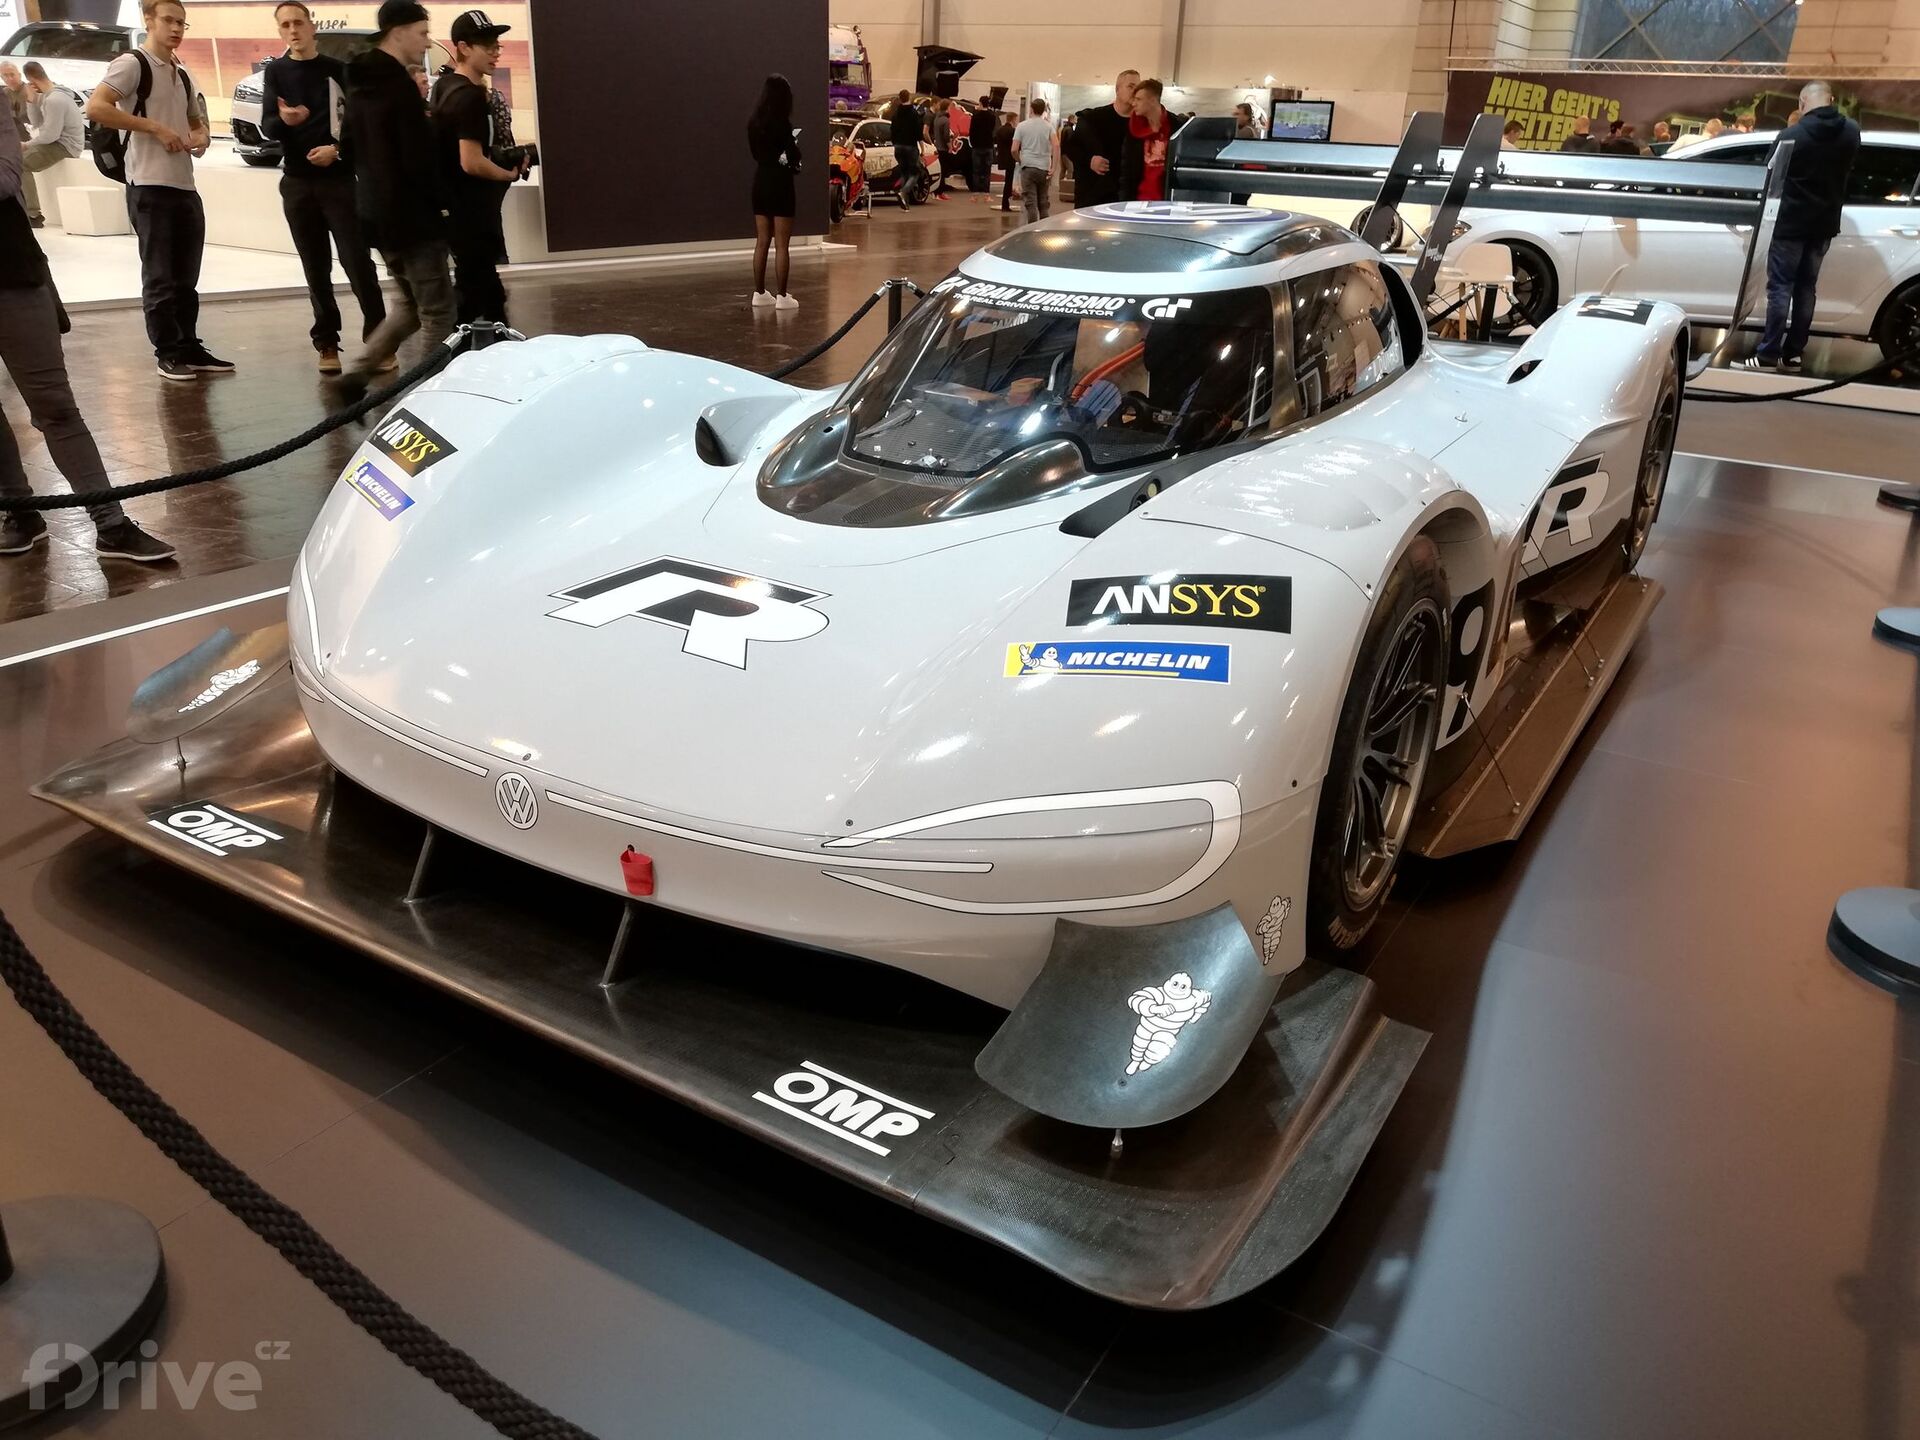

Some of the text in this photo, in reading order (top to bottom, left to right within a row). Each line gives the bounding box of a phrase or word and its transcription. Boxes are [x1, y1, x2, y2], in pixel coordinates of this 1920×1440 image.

[1486, 76, 1620, 123] HIER GEHT'S
[961, 282, 1127, 311] GRAN TURISMO
[994, 299, 1041, 311] DRIVING
[1041, 304, 1115, 317] SIMULATOR
[358, 473, 402, 510] MICHELIN
[1066, 652, 1210, 670] MICHELIN
[167, 810, 267, 848] OMP
[773, 1071, 920, 1139] OMP
